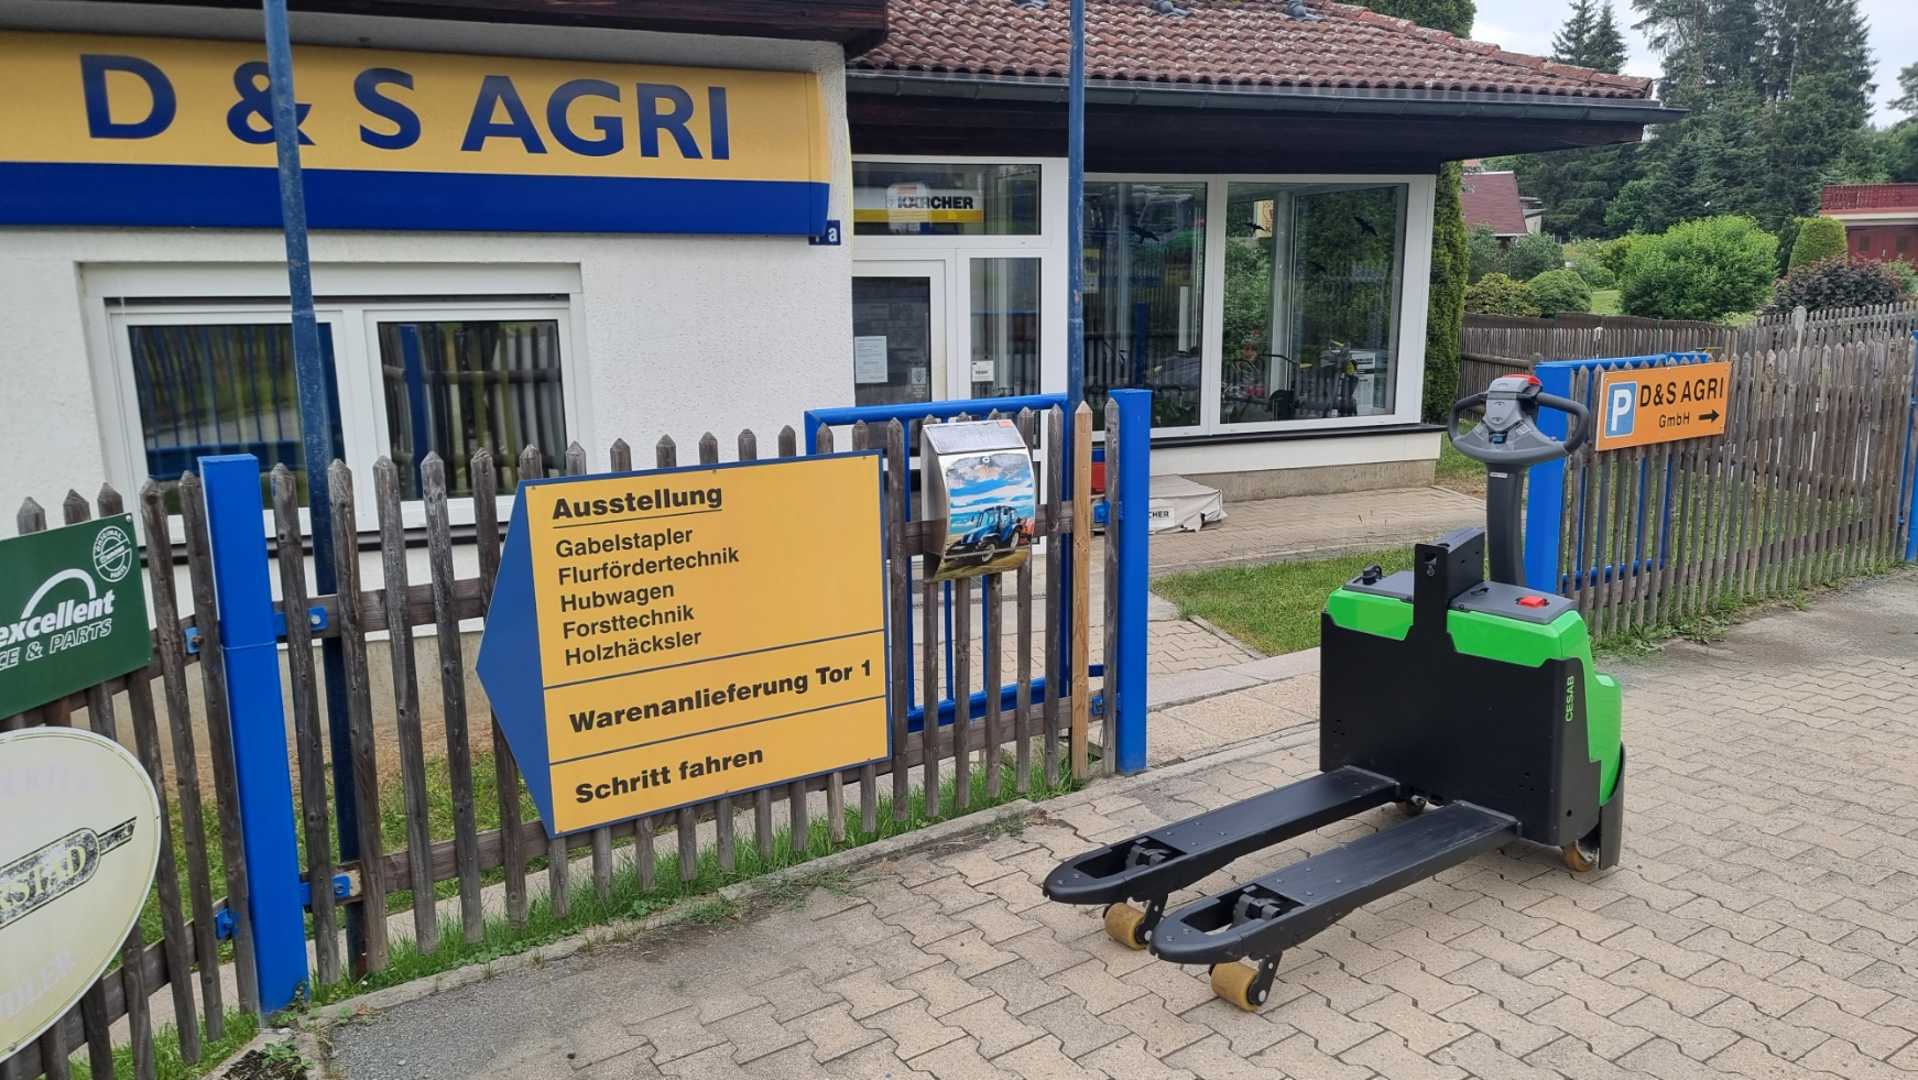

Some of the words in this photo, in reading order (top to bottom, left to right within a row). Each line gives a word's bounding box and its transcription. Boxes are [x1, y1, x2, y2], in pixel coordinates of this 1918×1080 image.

[79, 53, 177, 140] D
[225, 60, 316, 147] &
[353, 67, 422, 150] S
[460, 75, 730, 161] AGRI
[1680, 377, 1724, 403] AGRI
[1610, 388, 1632, 432] P
[1658, 412, 1690, 428] GmbH
[552, 487, 722, 520] Ausstellung
[555, 528, 693, 558] Gabelstapler
[558, 547, 740, 586] Flurfördertechnik
[560, 584, 674, 613] Hubwagen
[0, 590, 115, 648] excellent
[562, 605, 695, 640] Forsttechnik
[25, 641, 43, 661] &
[49, 618, 112, 654] PARTS
[565, 631, 702, 666] Holzhäcksler
[569, 674, 808, 733] Warenanlieferung
[815, 666, 853, 685] Tor
[861, 659, 871, 677] 1
[1565, 675, 1575, 721] CESAB
[575, 766, 672, 804] Schritt
[678, 749, 763, 781] fahren
